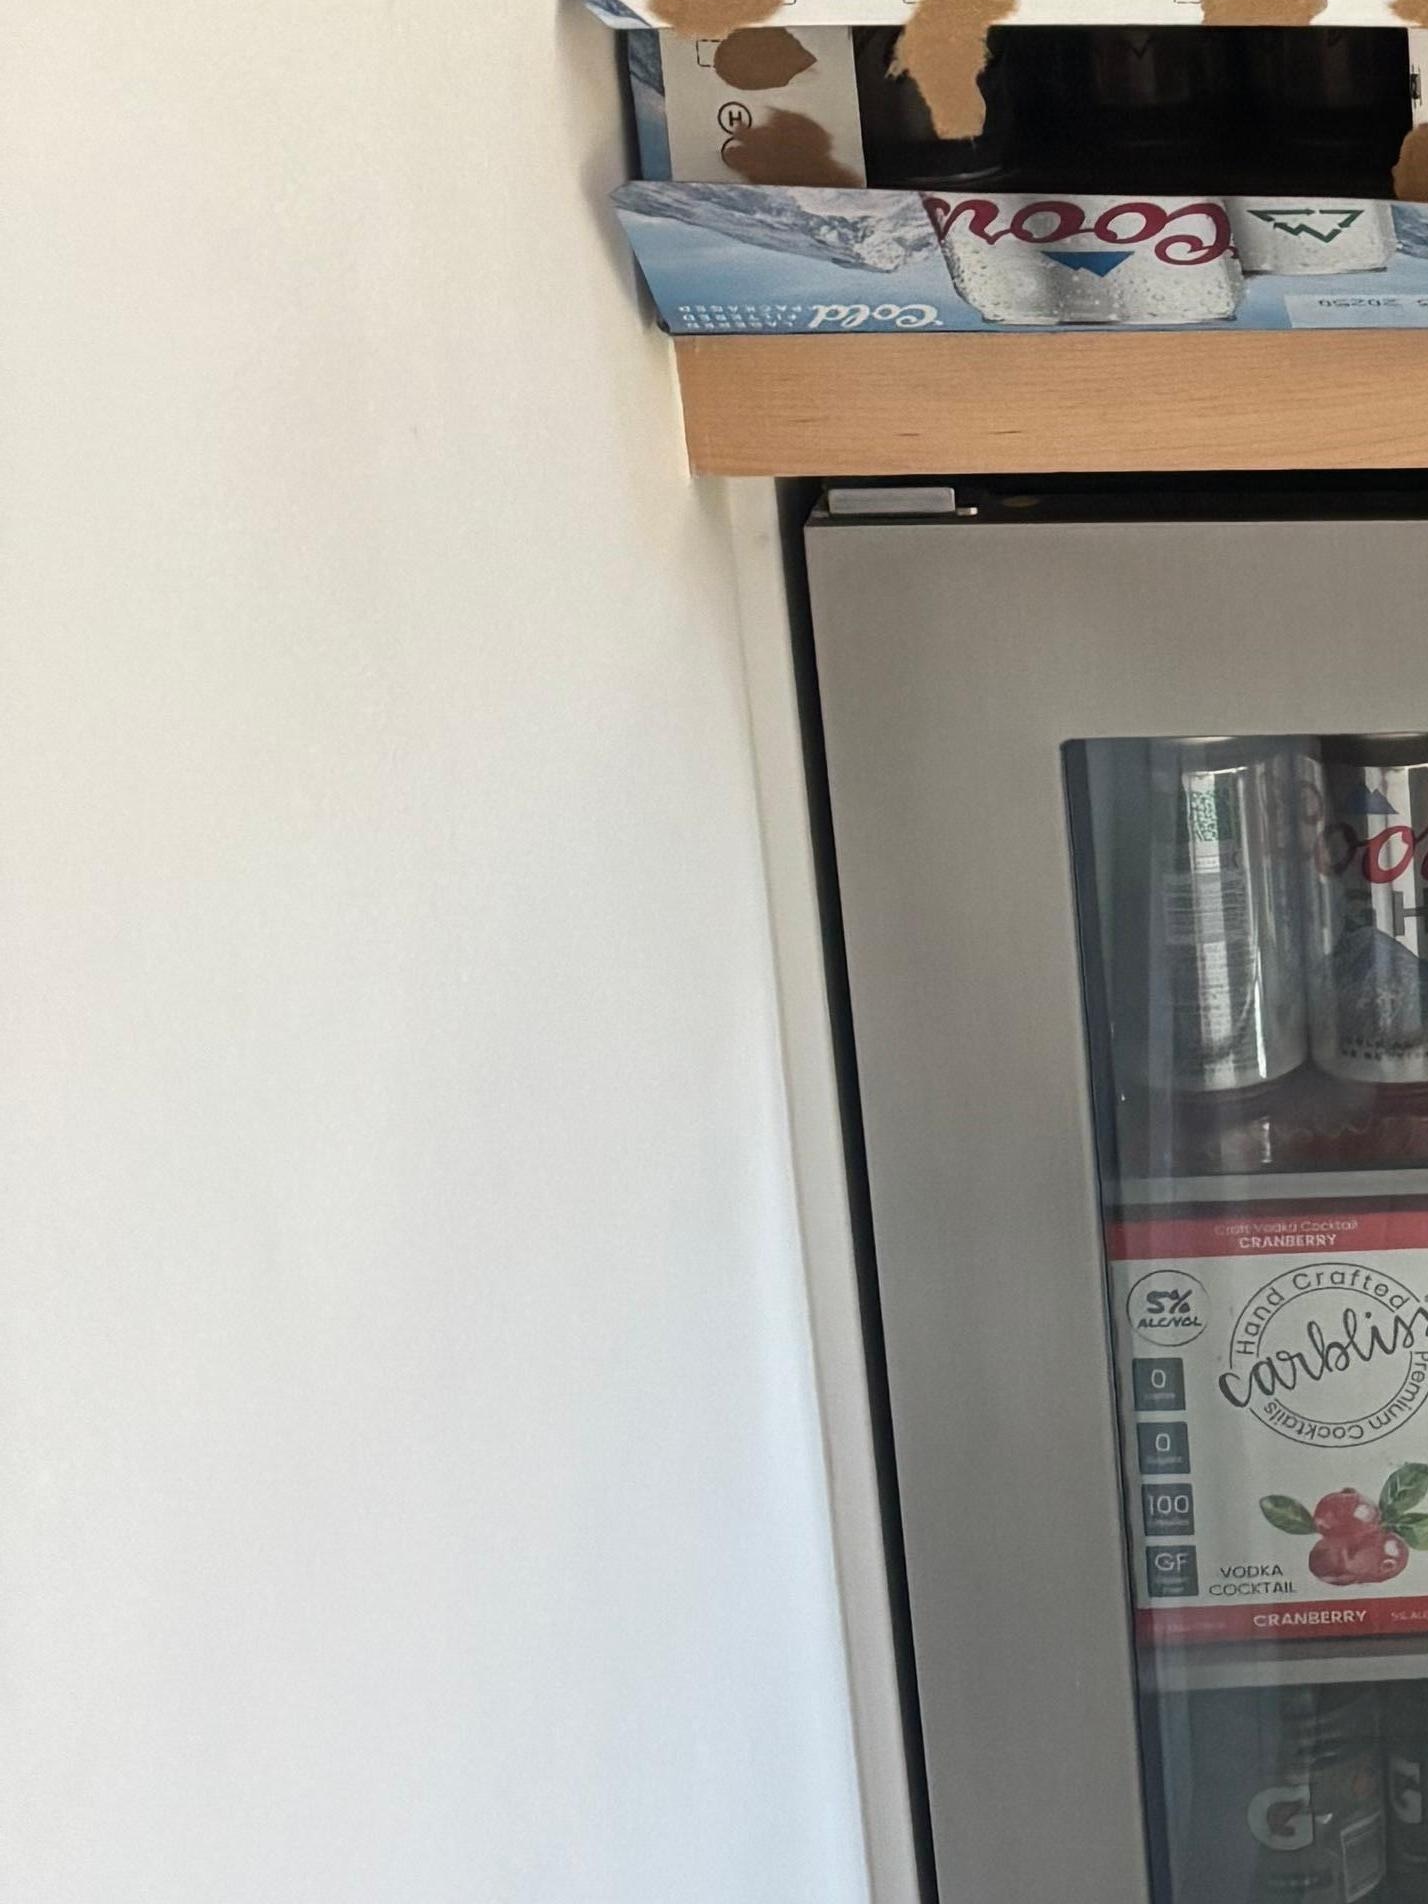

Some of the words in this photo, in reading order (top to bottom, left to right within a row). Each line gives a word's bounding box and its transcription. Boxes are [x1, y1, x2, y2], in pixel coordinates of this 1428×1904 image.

[808, 303, 944, 328] Cold
[1239, 1233, 1337, 1249] CRANBERRY
[1146, 1288, 1194, 1314] 5%
[1236, 1288, 1286, 1356] Hand
[1292, 1270, 1408, 1312] Crafted
[1264, 1401, 1364, 1440] Cocktails
[1149, 1495, 1190, 1514] 100
[1219, 1564, 1284, 1579] VODKA
[1208, 1580, 1296, 1597] COCKTAIL
[1253, 1610, 1368, 1628] CRANBERRY
[1247, 1784, 1315, 1851] G
